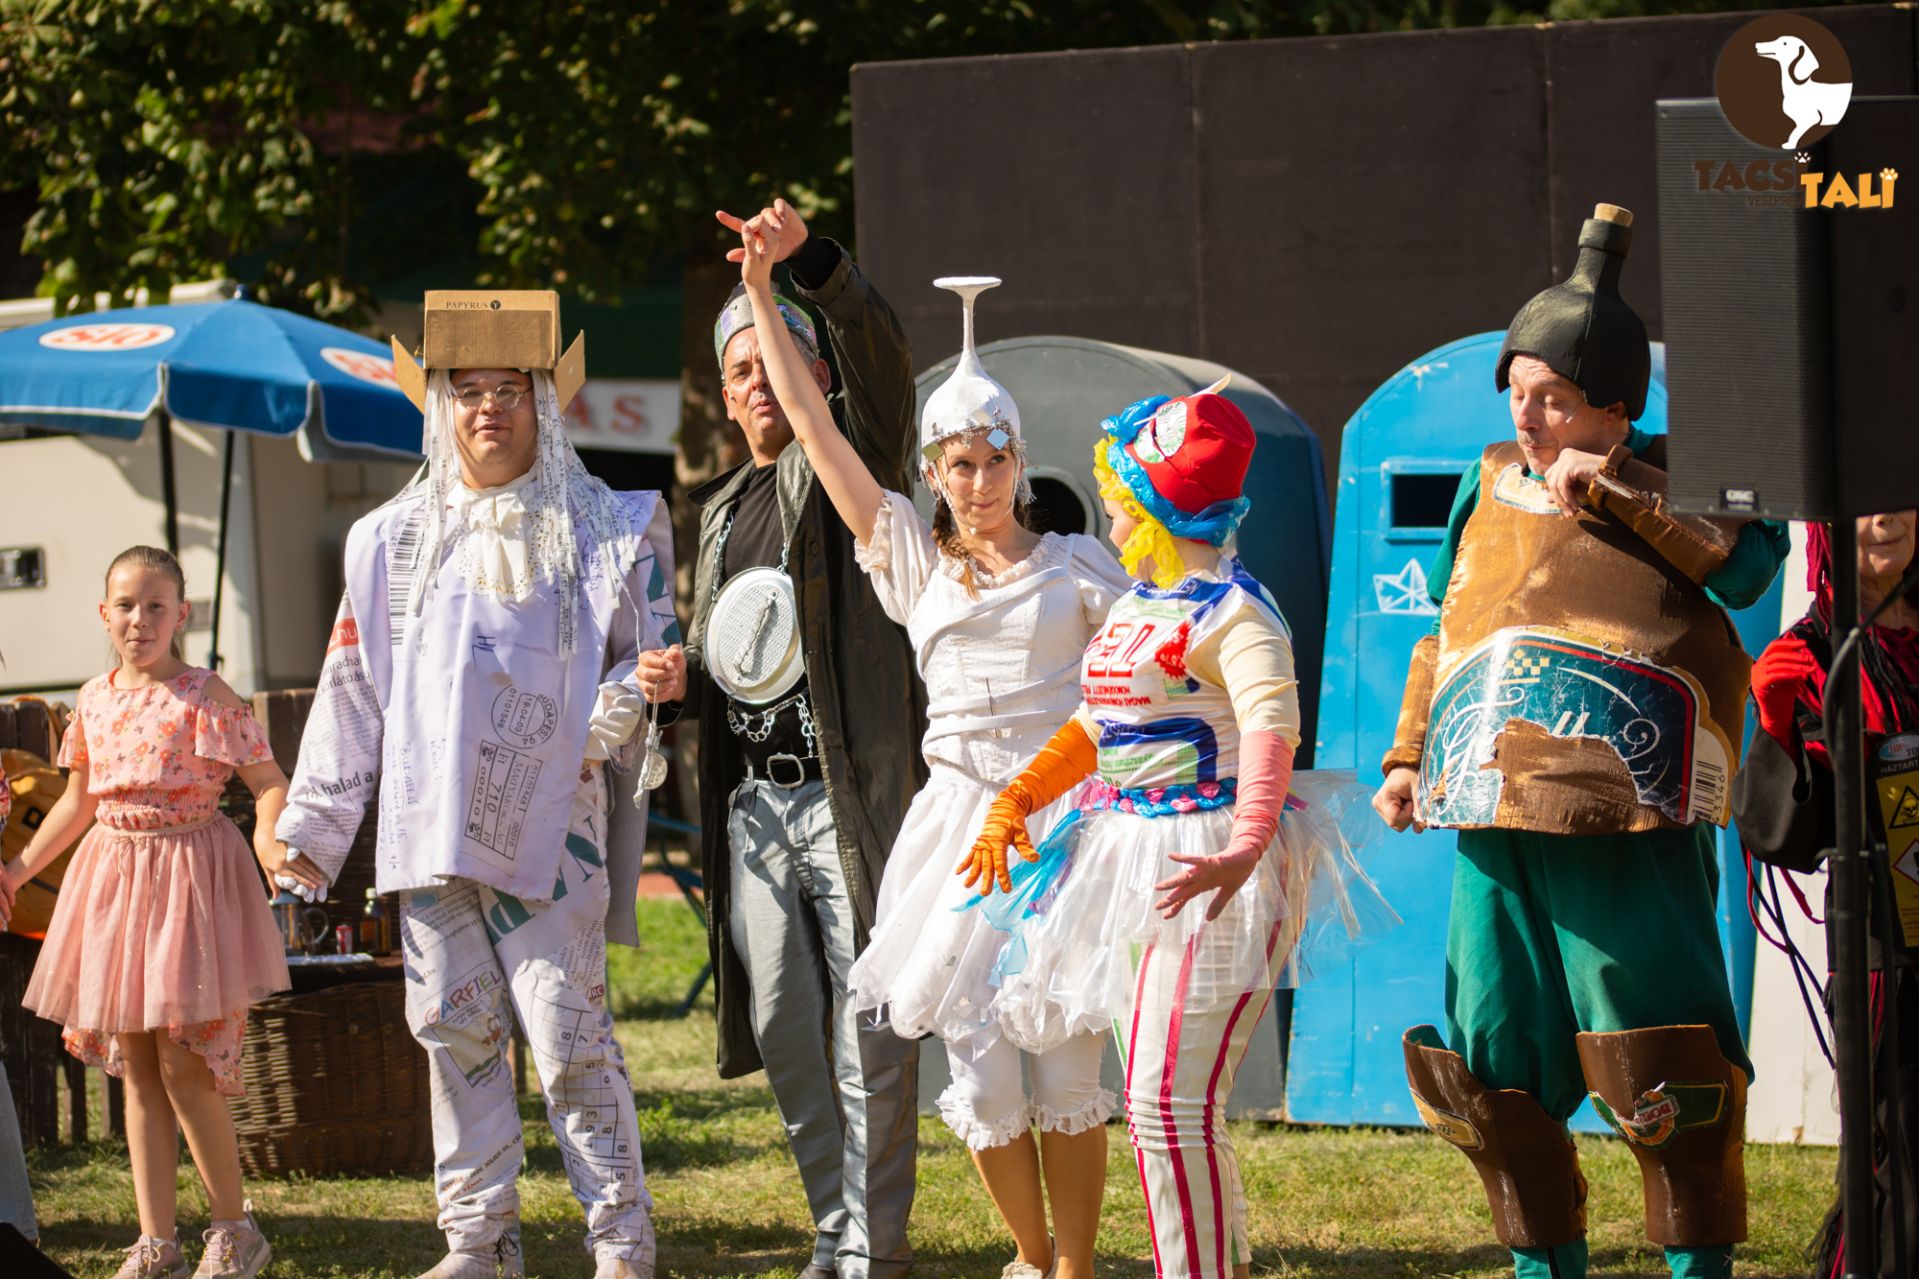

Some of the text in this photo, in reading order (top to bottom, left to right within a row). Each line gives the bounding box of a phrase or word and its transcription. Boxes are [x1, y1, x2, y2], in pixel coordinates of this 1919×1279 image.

[445, 301, 489, 309] PAPYRUS
[320, 770, 362, 797] halad
[364, 771, 375, 784] a
[487, 781, 502, 813] 710
